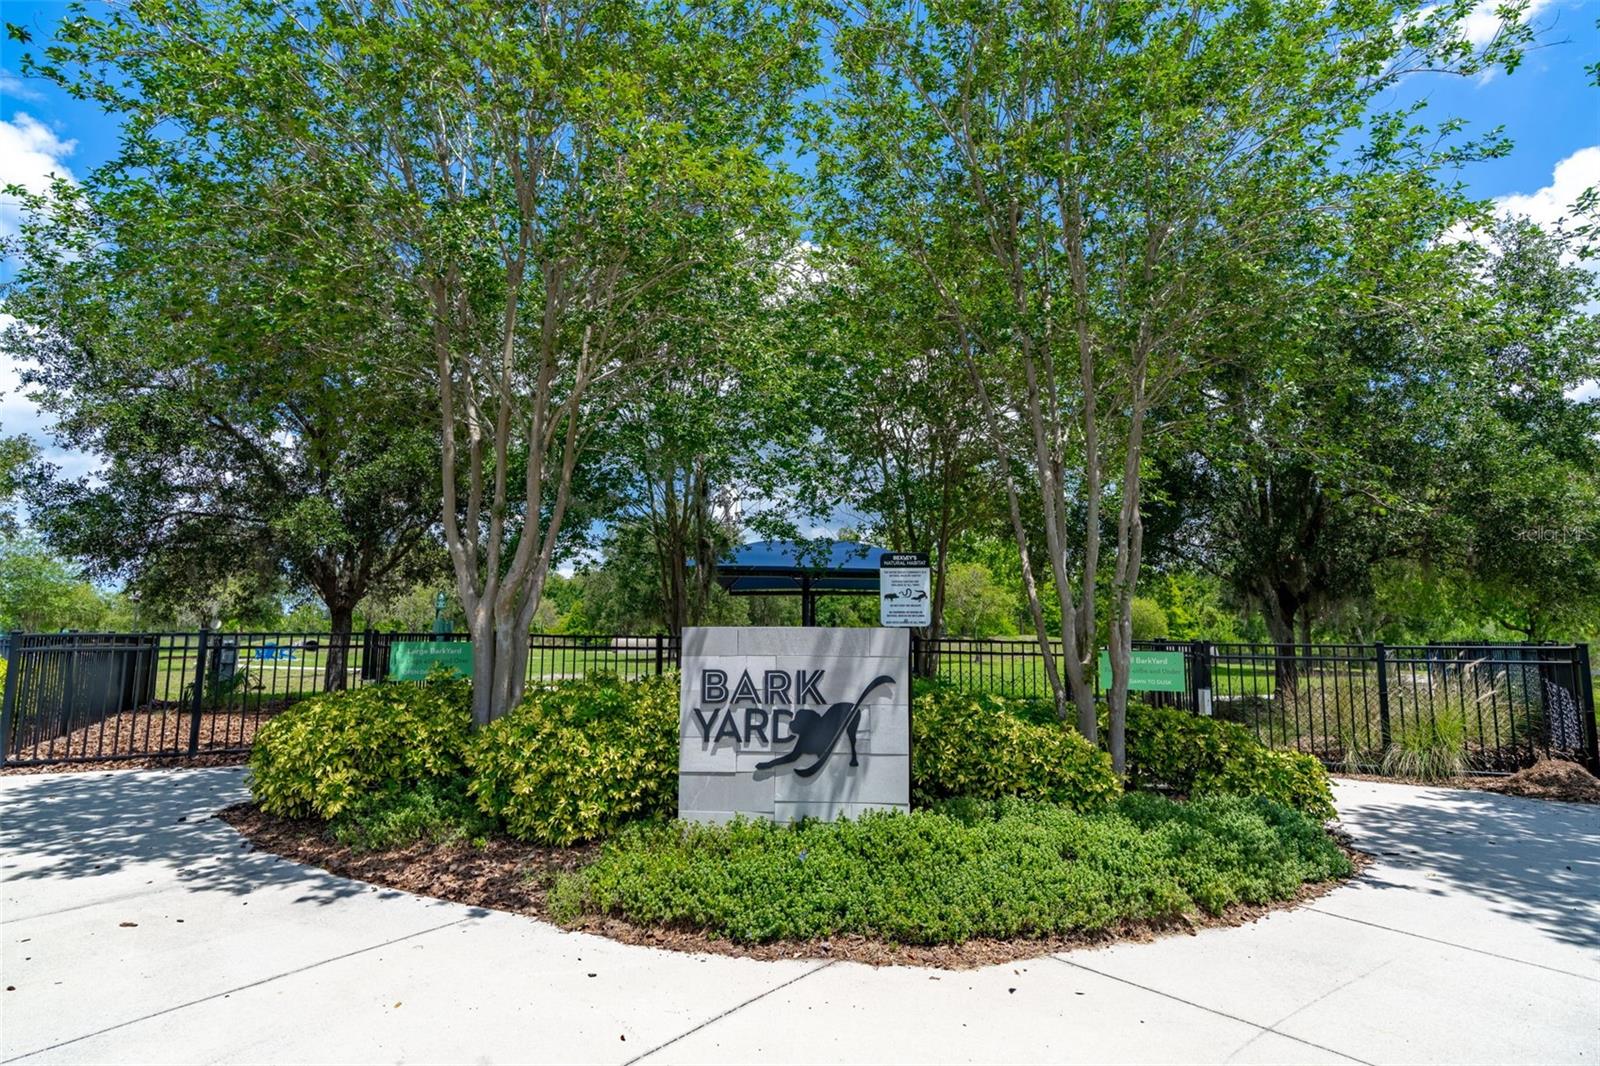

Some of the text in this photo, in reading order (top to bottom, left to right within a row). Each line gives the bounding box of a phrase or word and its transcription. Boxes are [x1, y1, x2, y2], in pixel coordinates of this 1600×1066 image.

[407, 648, 428, 656] Large
[1135, 656, 1168, 665] BarkYard
[701, 668, 827, 705] BARK
[693, 707, 798, 744] YARD
